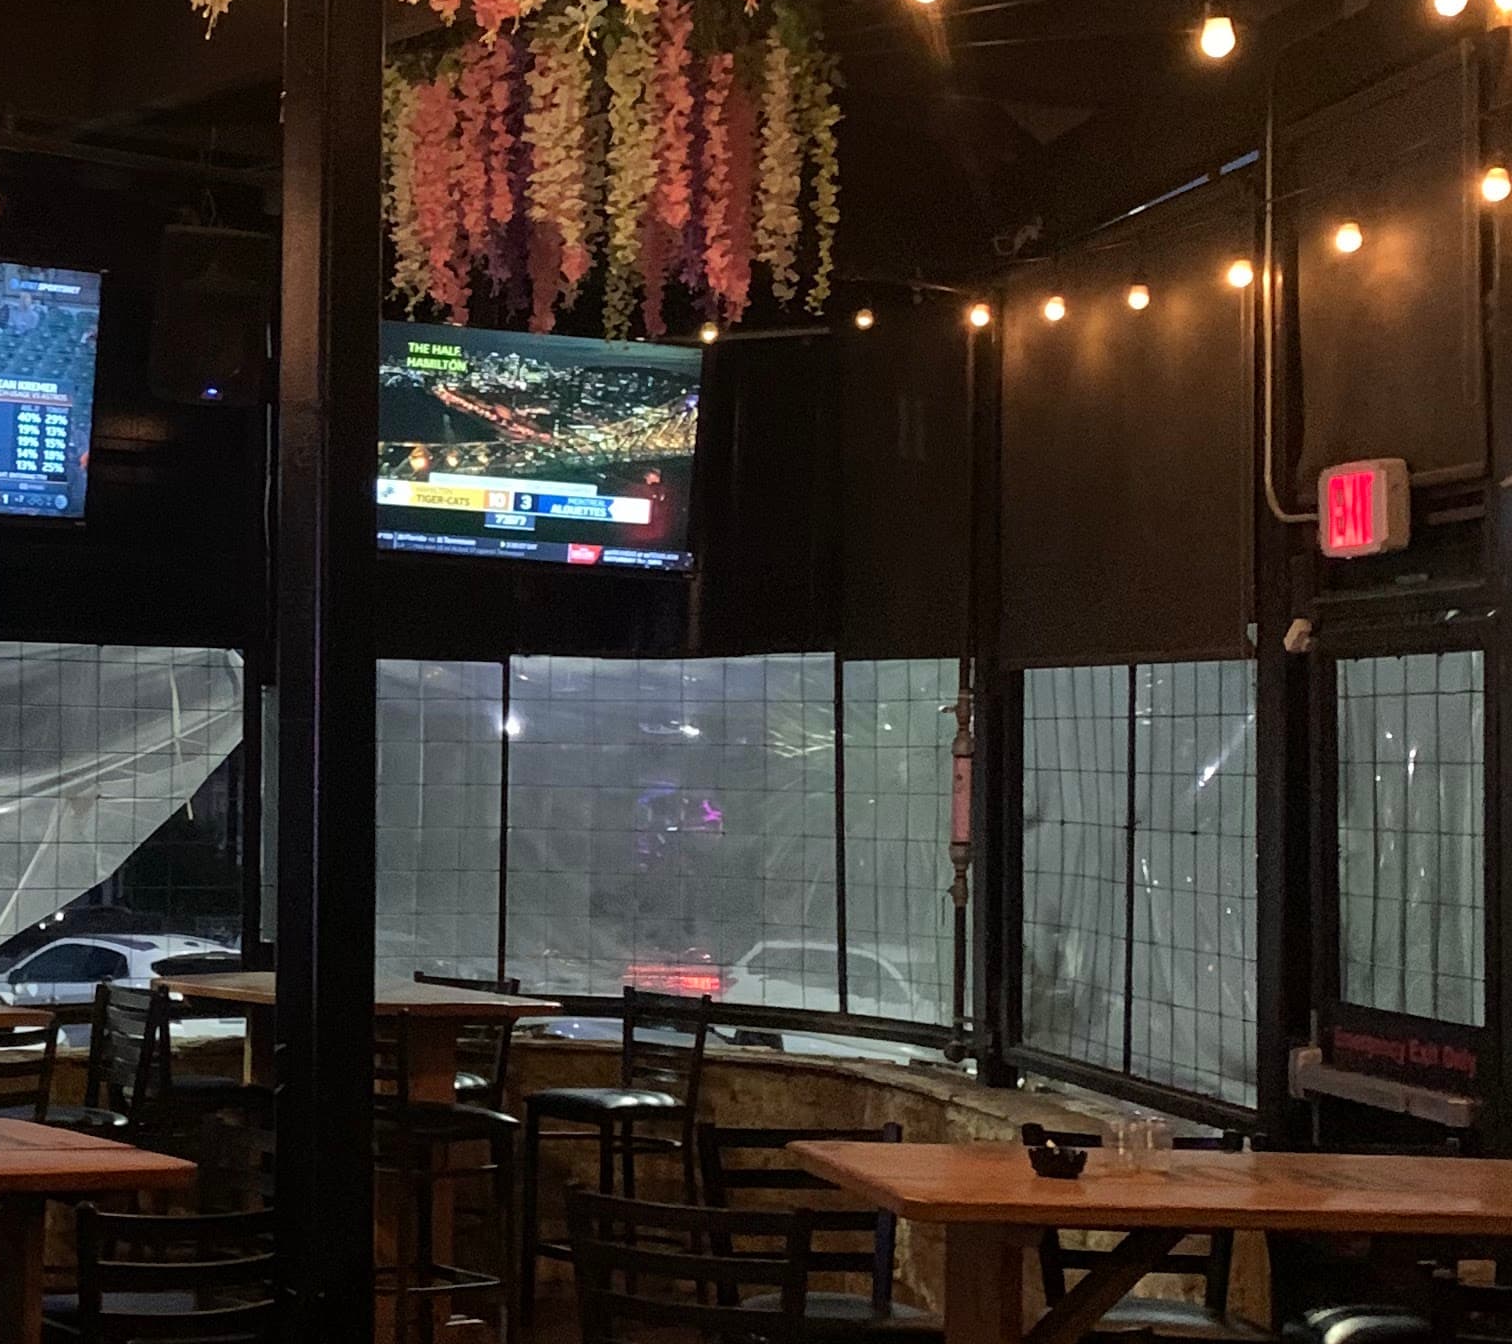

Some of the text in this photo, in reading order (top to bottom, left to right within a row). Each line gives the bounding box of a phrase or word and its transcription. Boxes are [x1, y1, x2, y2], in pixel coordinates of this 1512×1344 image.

[408, 342, 430, 354] THE
[416, 493, 471, 507] TIGER-CATS
[489, 491, 532, 510] 10 3
[1329, 472, 1374, 548] EXIT
